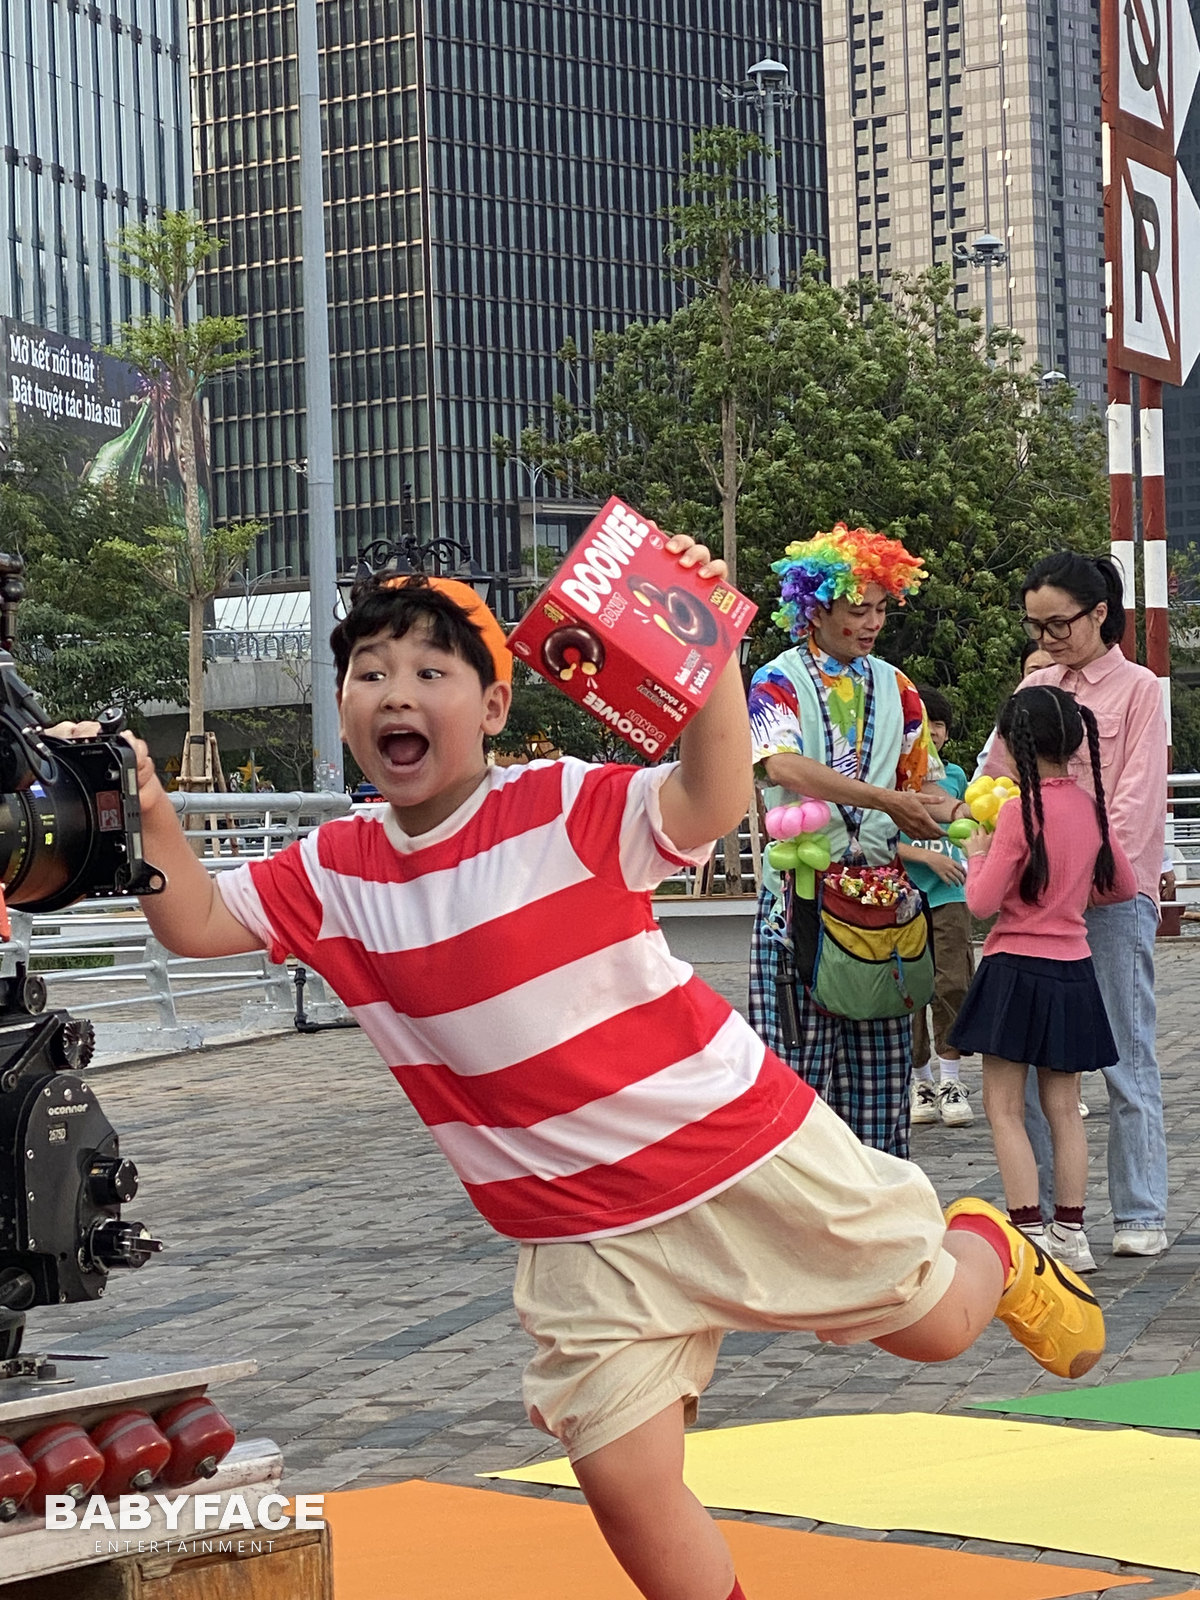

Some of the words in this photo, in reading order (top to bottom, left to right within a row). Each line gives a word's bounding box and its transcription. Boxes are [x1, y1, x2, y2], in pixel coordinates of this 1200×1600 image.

[1133, 189, 1160, 324] P
[10, 334, 29, 365] Mở
[30, 338, 50, 372] kết
[52, 344, 70, 377] nối
[72, 353, 95, 389] thật
[11, 375, 33, 412] Bật
[34, 383, 63, 420] tuyệt
[65, 389, 82, 418] tác
[84, 394, 102, 424] bia
[104, 398, 122, 428] sủi
[561, 504, 650, 614] DOOWEE
[598, 591, 628, 629] DONUT
[709, 586, 727, 606] 100%
[582, 690, 659, 754] DOOWEE
[624, 708, 666, 742] DONUT
[662, 703, 683, 722] Bánh
[48, 1103, 88, 1116] oconnor
